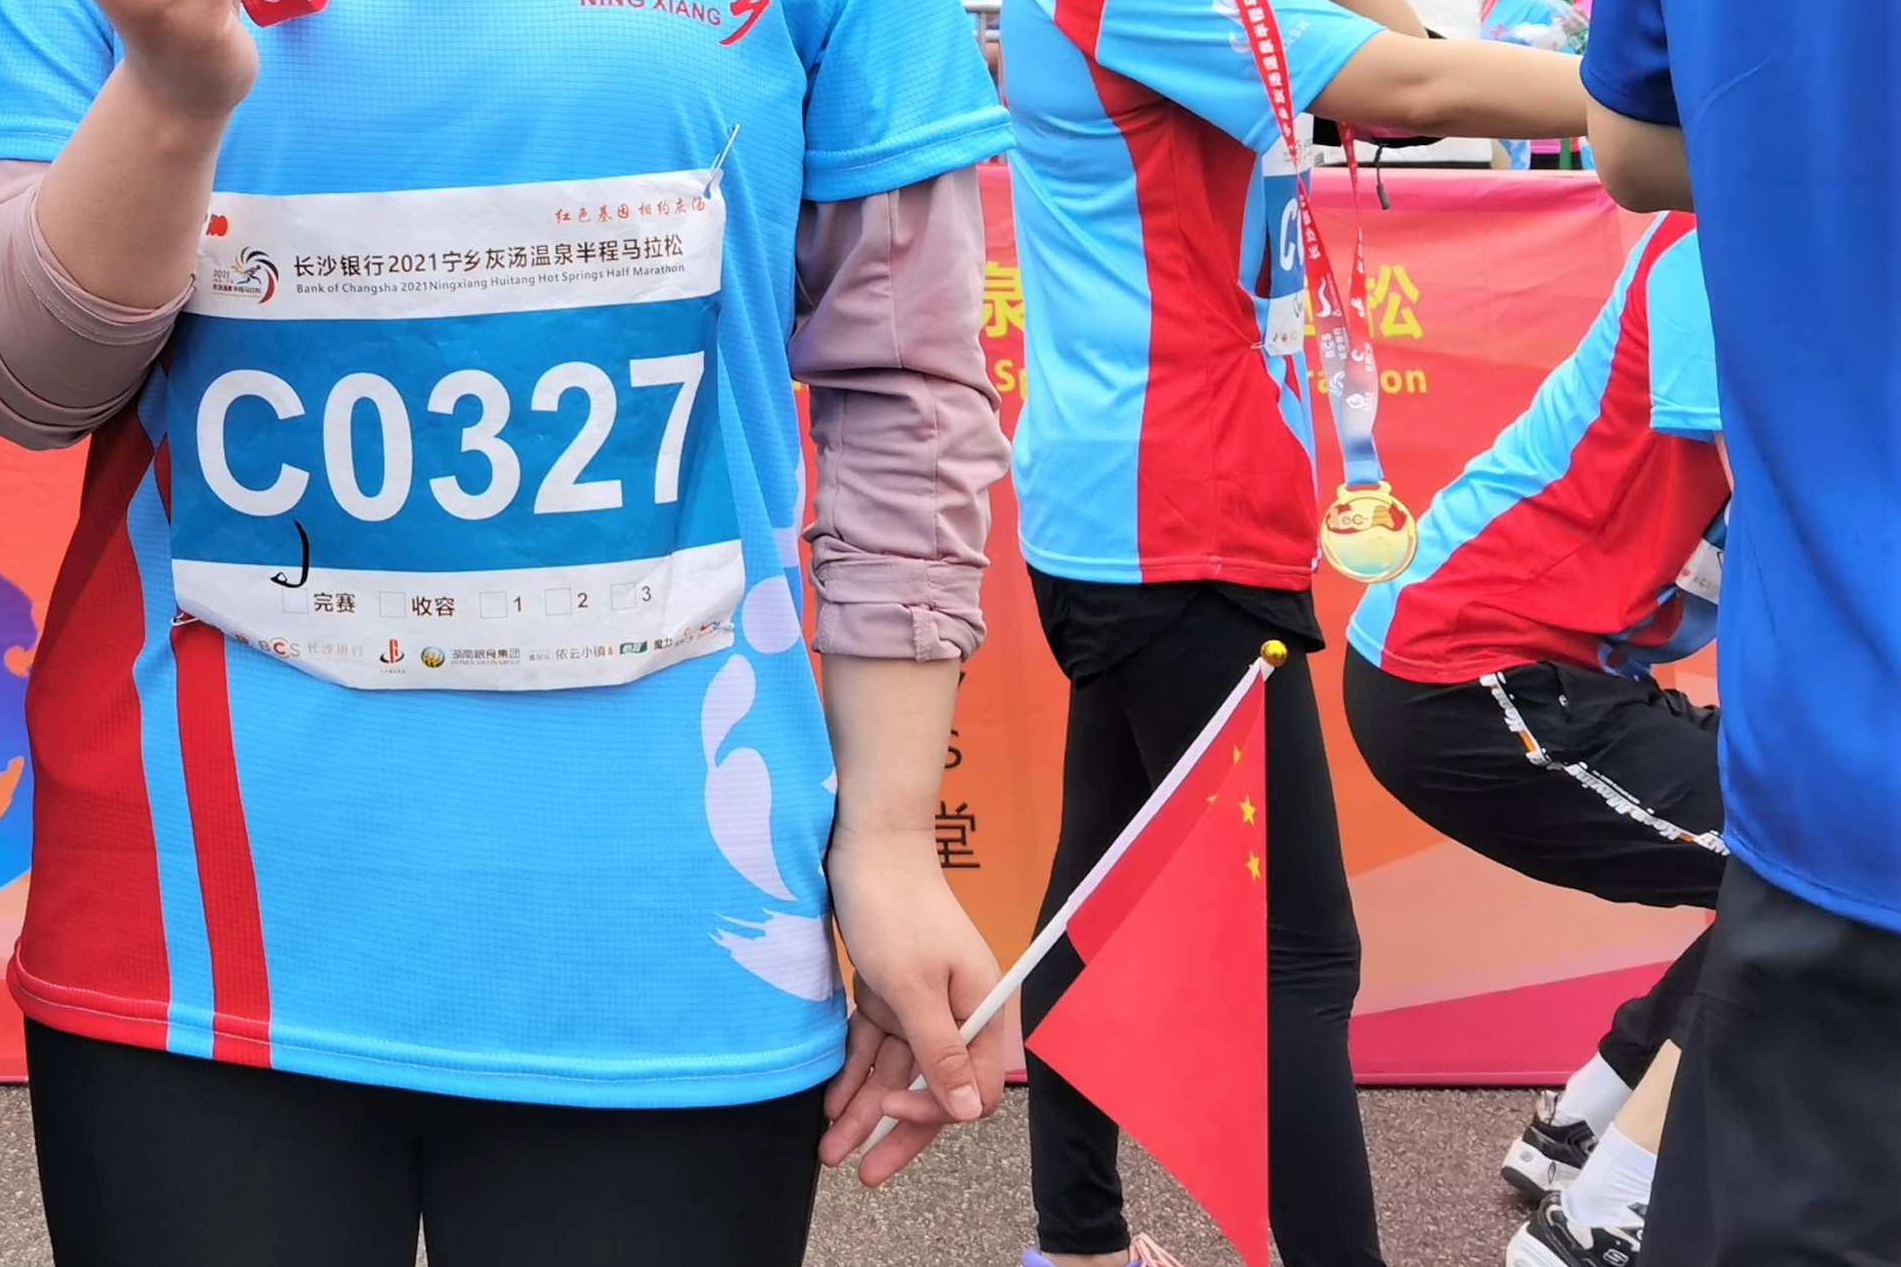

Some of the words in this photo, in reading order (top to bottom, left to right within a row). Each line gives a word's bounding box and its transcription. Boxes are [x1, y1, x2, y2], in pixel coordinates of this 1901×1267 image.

[294, 233, 684, 277] 长沙银行2021宁乡灰汤温泉半程马拉松
[296, 283, 325, 294] Bank
[327, 282, 339, 293] of
[341, 282, 398, 296] Changsha
[490, 272, 536, 288] Huitang
[538, 272, 559, 284] Hot
[562, 267, 604, 283] Springs
[606, 267, 630, 278] Half
[633, 263, 685, 277] Marathon
[196, 350, 705, 522] C0327
[313, 592, 357, 613] 完赛
[411, 596, 456, 618] 收容
[513, 596, 522, 612] 1
[577, 592, 589, 609] 2
[641, 586, 652, 602] 3
[258, 637, 300, 659] BCS
